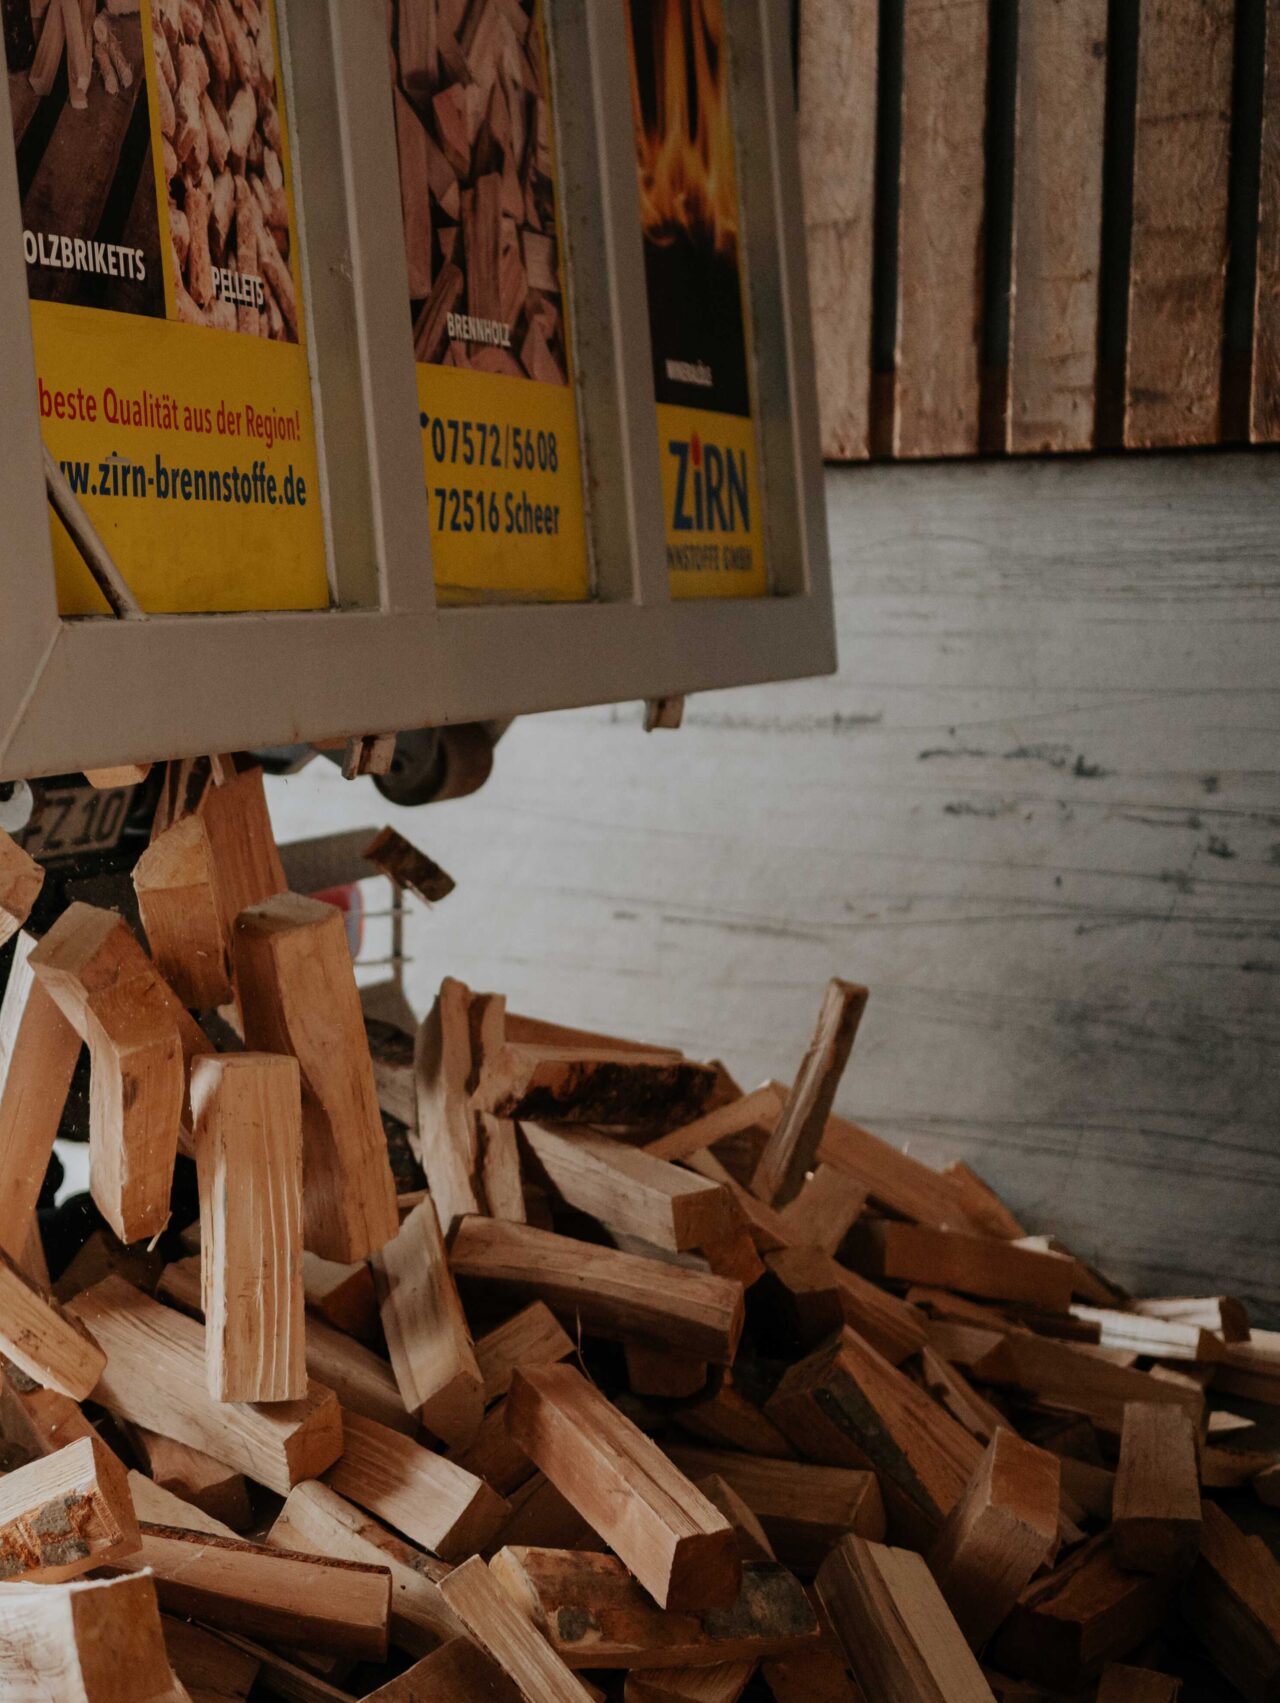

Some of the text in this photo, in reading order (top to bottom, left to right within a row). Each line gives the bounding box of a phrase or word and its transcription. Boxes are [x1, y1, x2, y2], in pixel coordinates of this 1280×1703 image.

[211, 265, 264, 306] PELLETS
[446, 311, 512, 348] BRENNHOLZ
[37, 377, 301, 449] beste Qualität aus der Region!
[434, 488, 560, 535] 72516 Scheer
